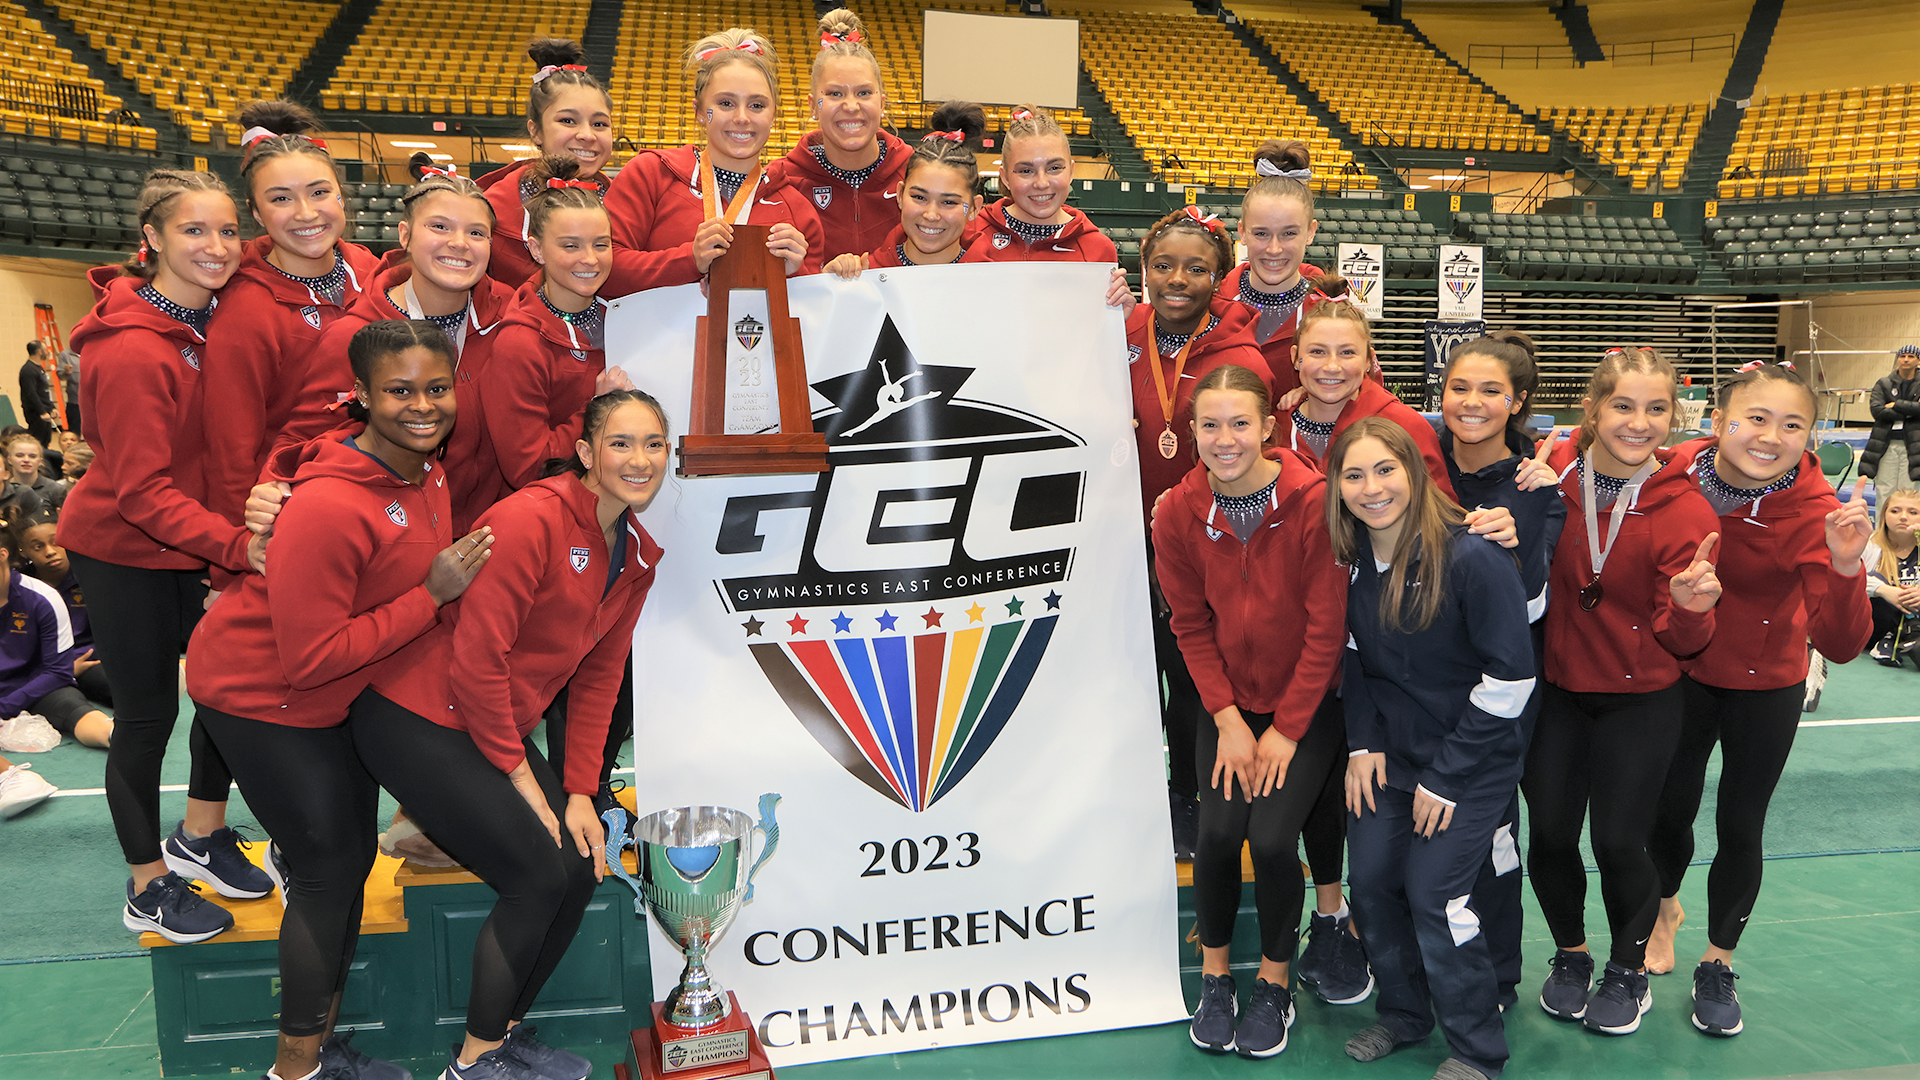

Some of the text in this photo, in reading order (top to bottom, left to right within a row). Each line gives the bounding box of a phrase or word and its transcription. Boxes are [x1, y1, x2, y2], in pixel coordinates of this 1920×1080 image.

[197, 159, 206, 168] 11
[1187, 188, 1195, 197] 6
[1406, 195, 1413, 204] 6
[1452, 196, 1459, 205] 5
[1655, 203, 1661, 211] 5
[1708, 202, 1715, 211] 3
[1342, 260, 1381, 274] GEC
[1442, 262, 1480, 276] GEC
[739, 357, 762, 371] 20
[739, 370, 762, 386] 23
[713, 450, 1085, 576] GEC
[737, 560, 1062, 602] GYMNASTICS EAST CONFERENCE
[858, 831, 981, 878] 2023
[743, 894, 1096, 967] CONFERENCE
[758, 972, 1092, 1048] CHAMPIONS
[690, 1041, 744, 1055] EAST CONFERENCE
[697, 1037, 737, 1047] GYMNASTICS
[691, 1048, 744, 1063] CHAMPIONS
